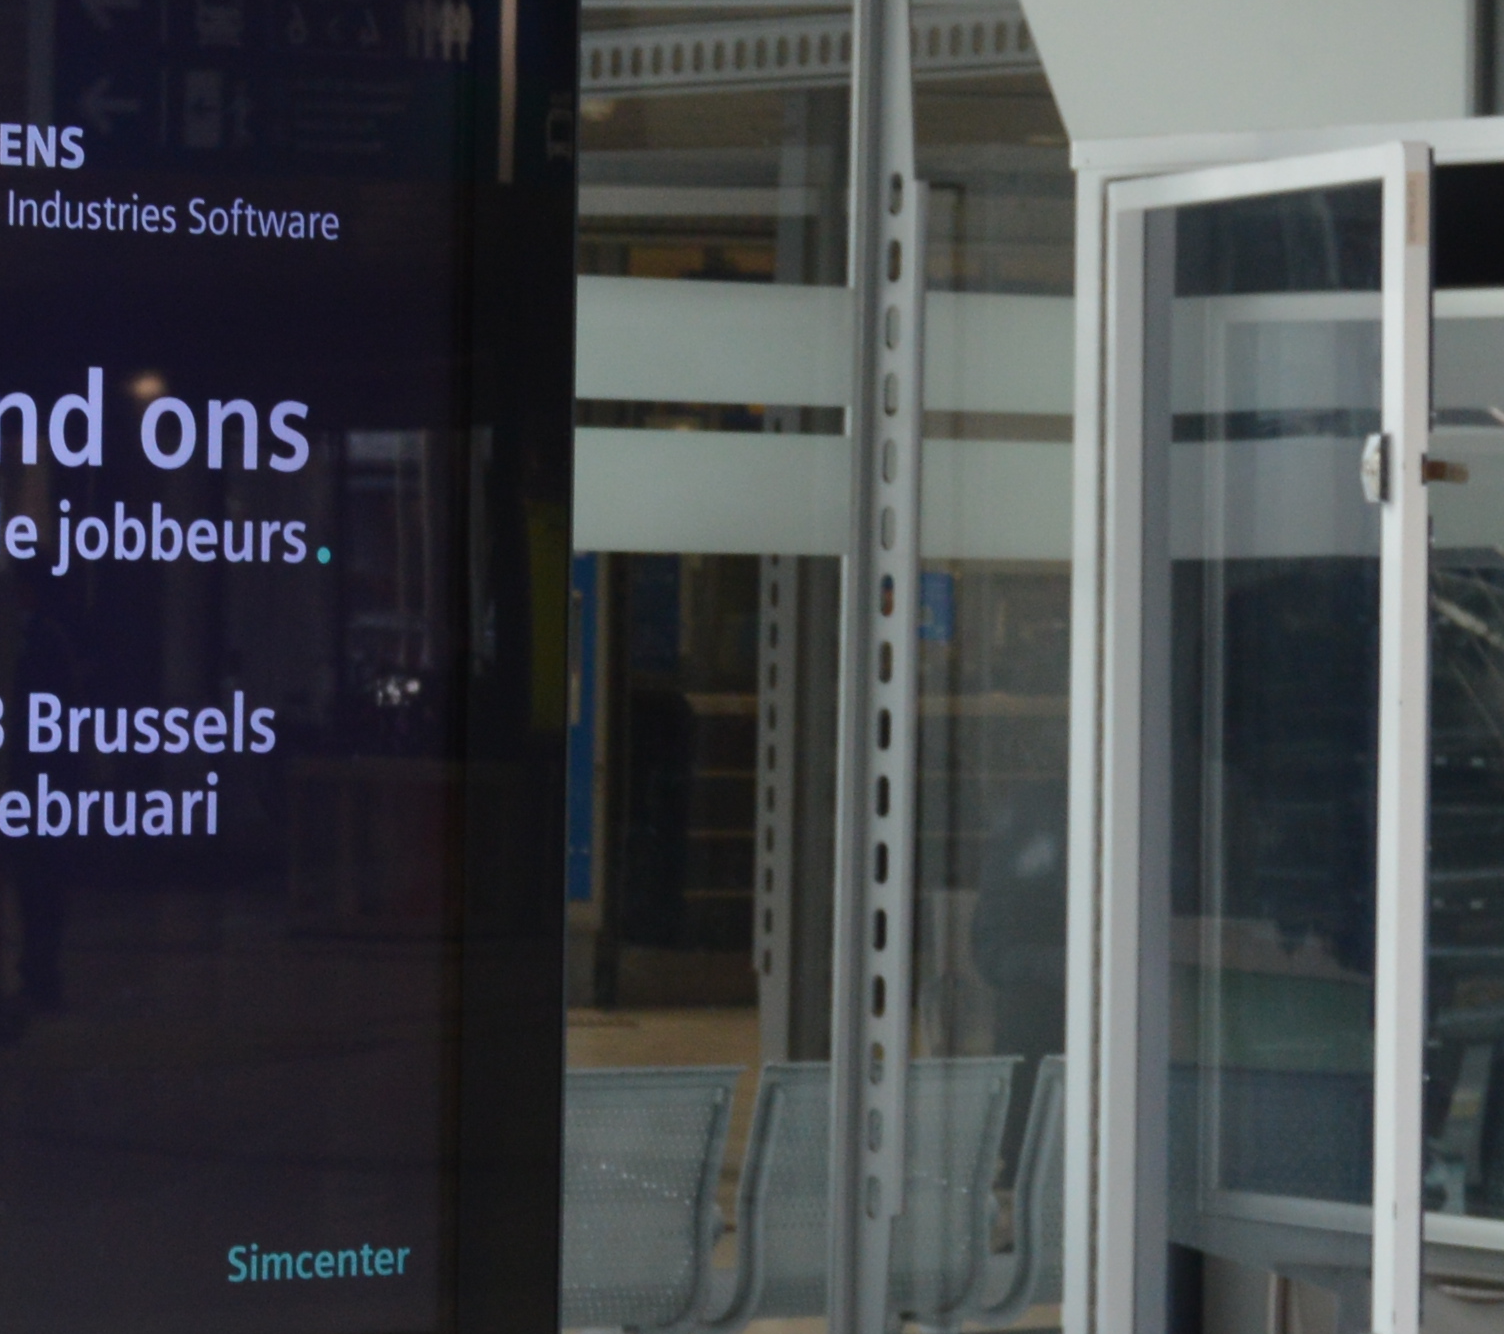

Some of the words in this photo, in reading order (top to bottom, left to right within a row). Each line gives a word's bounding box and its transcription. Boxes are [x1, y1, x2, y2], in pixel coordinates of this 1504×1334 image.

[9, 190, 176, 233] Industries
[189, 198, 339, 240] Software
[141, 397, 309, 472] ons
[52, 499, 330, 576] jobbeurs.
[29, 690, 275, 753] Brussels
[228, 1243, 410, 1282] Simcenter
